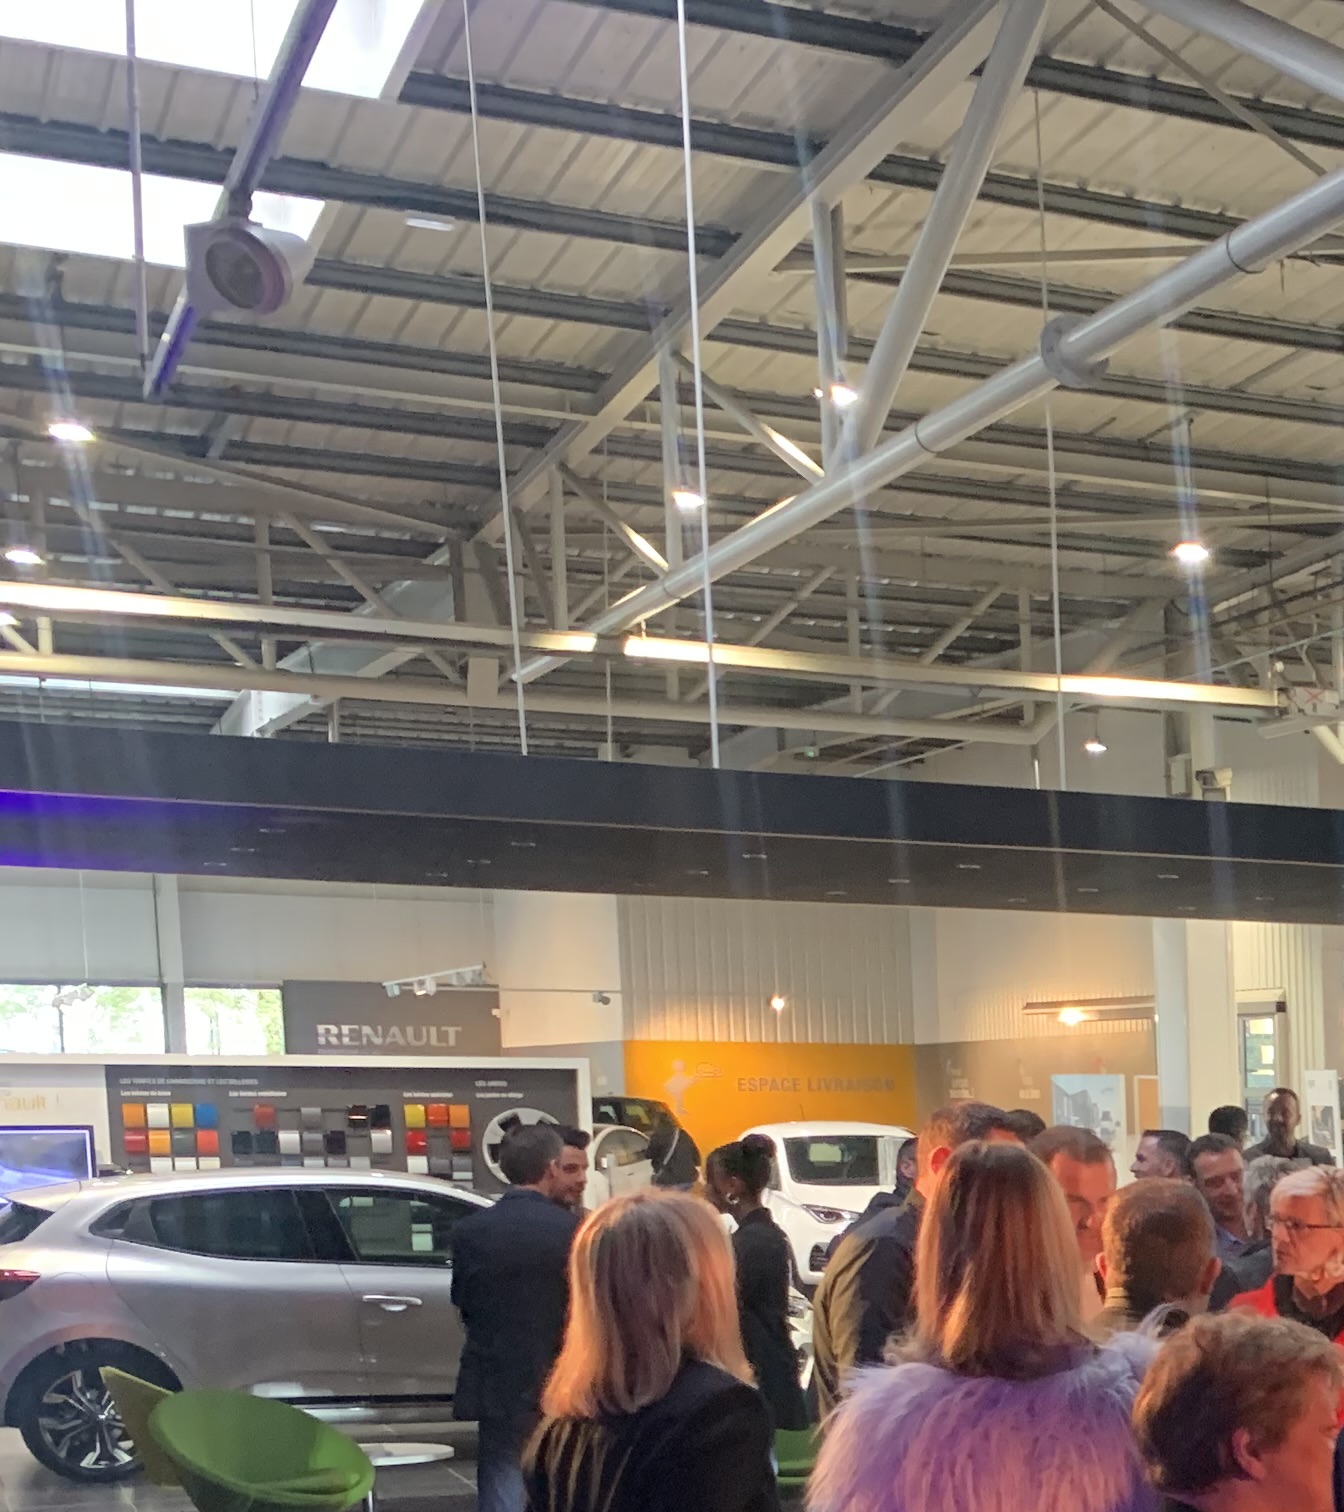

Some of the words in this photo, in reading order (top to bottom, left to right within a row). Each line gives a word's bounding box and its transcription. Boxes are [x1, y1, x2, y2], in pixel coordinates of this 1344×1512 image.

[316, 1024, 462, 1047] RENAULT
[737, 1077, 801, 1092] ESPACE
[807, 1077, 896, 1093] LIVRAISON
